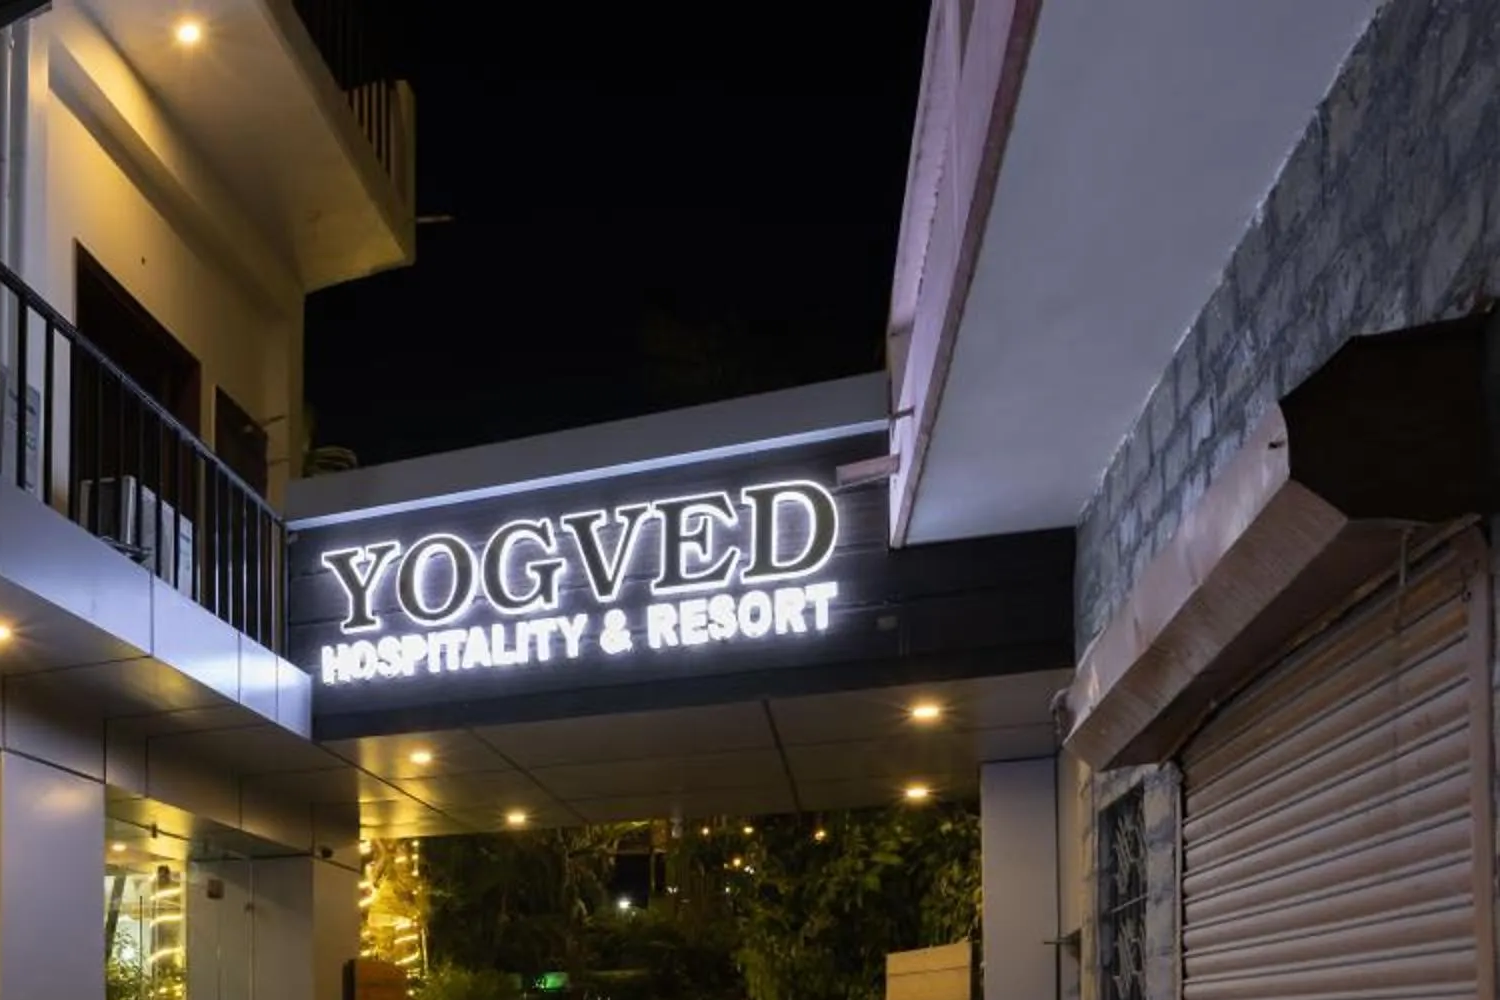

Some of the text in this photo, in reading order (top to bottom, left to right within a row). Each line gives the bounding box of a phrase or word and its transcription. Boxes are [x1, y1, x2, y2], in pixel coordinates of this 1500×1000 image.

[323, 481, 839, 633] YOGVED
[321, 582, 839, 684] HOSPITALITY & RESORT
